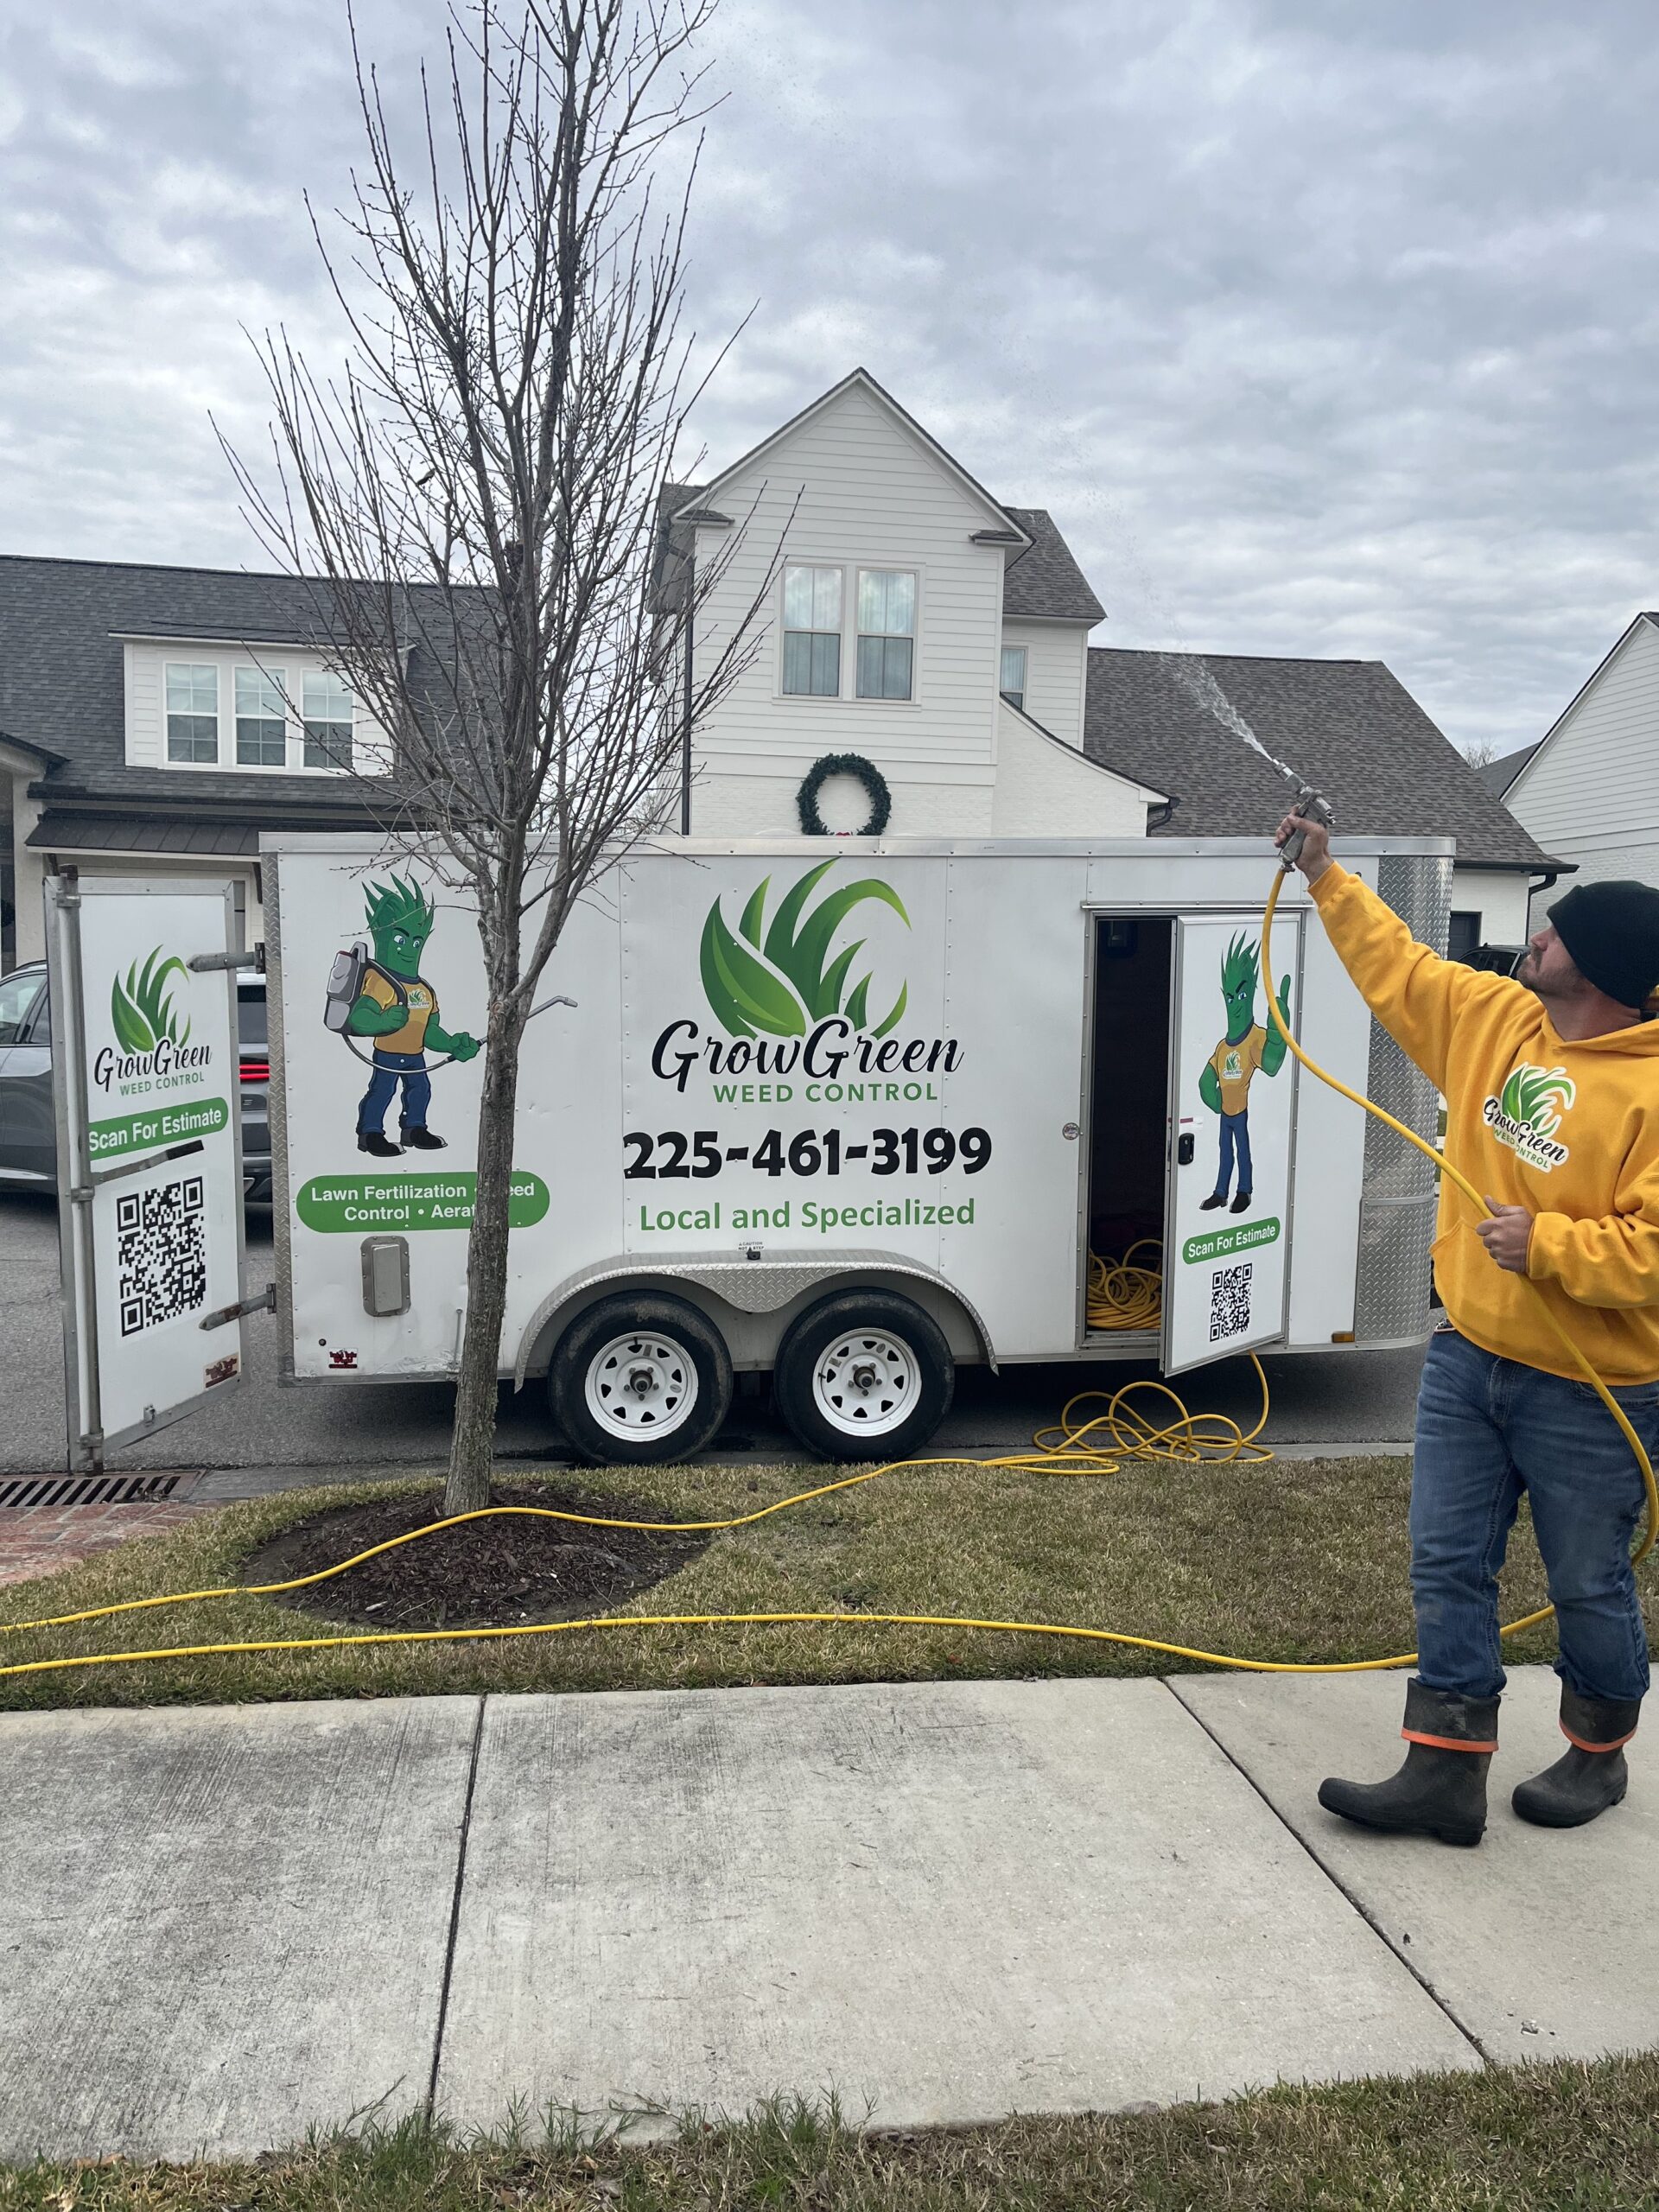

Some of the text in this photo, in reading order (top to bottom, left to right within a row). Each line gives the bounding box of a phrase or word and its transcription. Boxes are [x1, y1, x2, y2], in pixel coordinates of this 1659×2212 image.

[94, 1039, 213, 1092] GrowGreen
[652, 1019, 964, 1093] GrowGreen
[119, 1071, 205, 1096] WEED CONTROL
[713, 1082, 938, 1103] WEED CONTROL
[89, 1108, 221, 1152] Scan For Estimate
[1484, 1098, 1566, 1162] GrowGreen
[623, 1126, 992, 1179] 225-461-3199
[1516, 1144, 1548, 1168] ONTROL
[311, 1187, 359, 1202] Lawn
[365, 1184, 467, 1199] Fertilization
[344, 1204, 476, 1221] Control Aerat
[640, 1198, 975, 1233] Local and Specialized
[1188, 1224, 1276, 1258] Scan For Estimate
